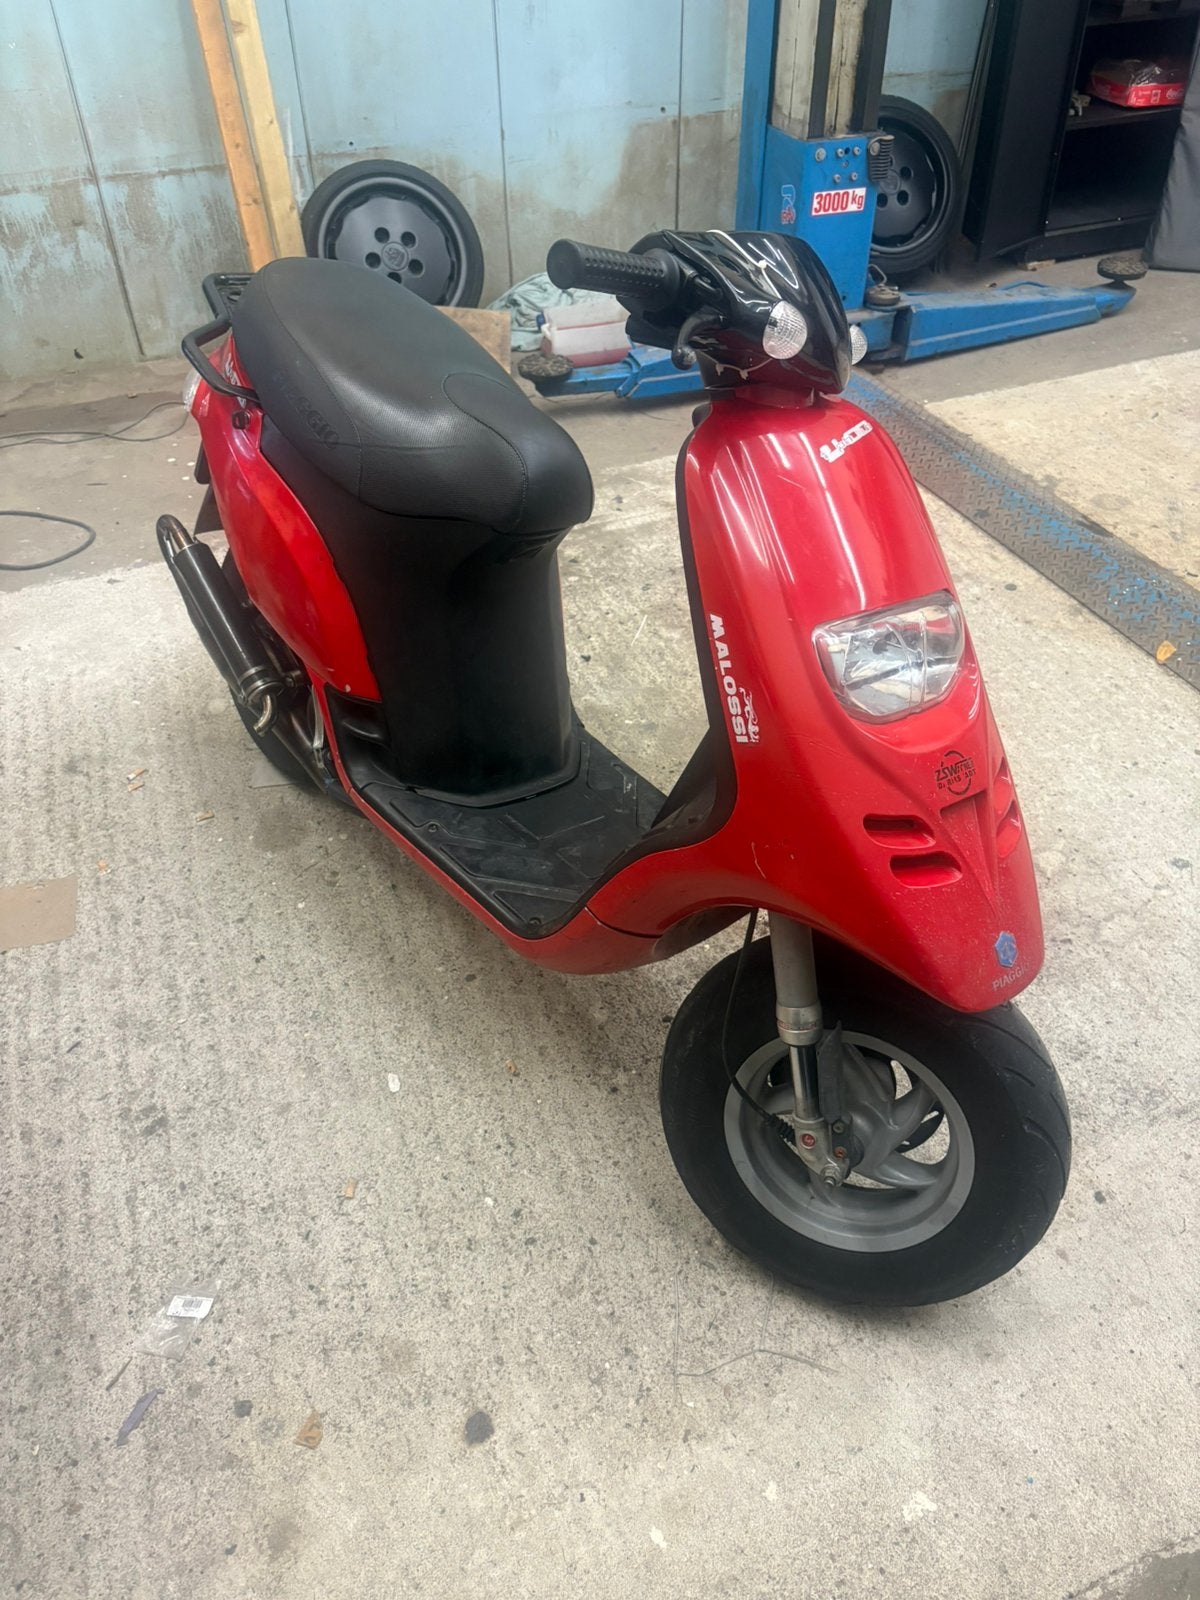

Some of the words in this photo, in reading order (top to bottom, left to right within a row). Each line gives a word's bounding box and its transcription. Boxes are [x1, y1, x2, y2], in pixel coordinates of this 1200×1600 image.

[814, 191, 849, 213] 3000
[851, 190, 864, 209] kg
[710, 613, 749, 743] MALOSSI
